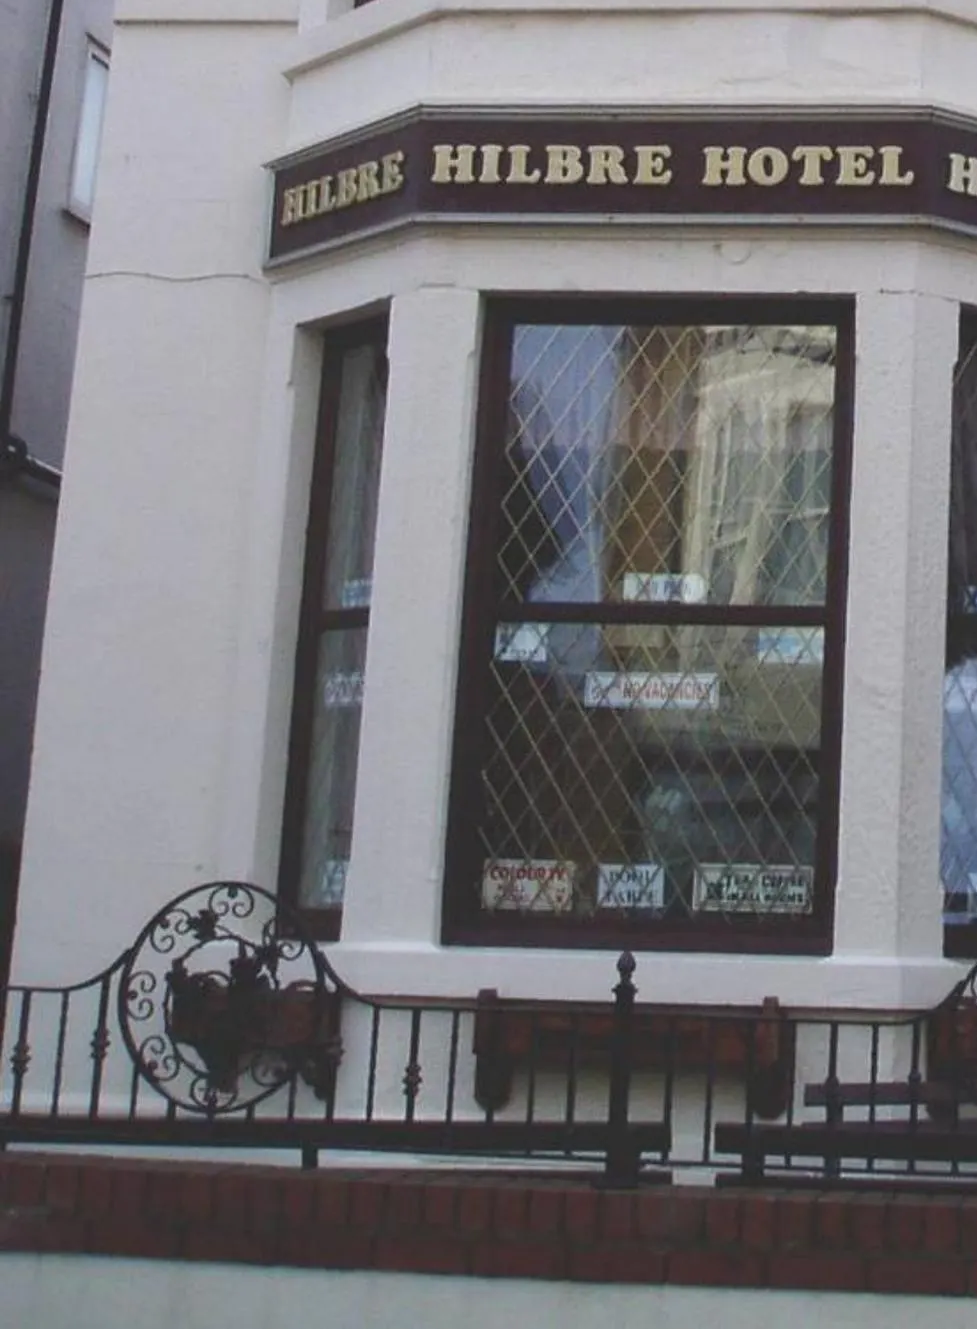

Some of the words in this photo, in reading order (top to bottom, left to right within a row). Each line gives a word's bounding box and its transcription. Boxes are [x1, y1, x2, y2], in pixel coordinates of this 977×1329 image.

[282, 152, 405, 226] HILBRE
[432, 144, 673, 185] HILBRE
[701, 145, 915, 188] HOTEL
